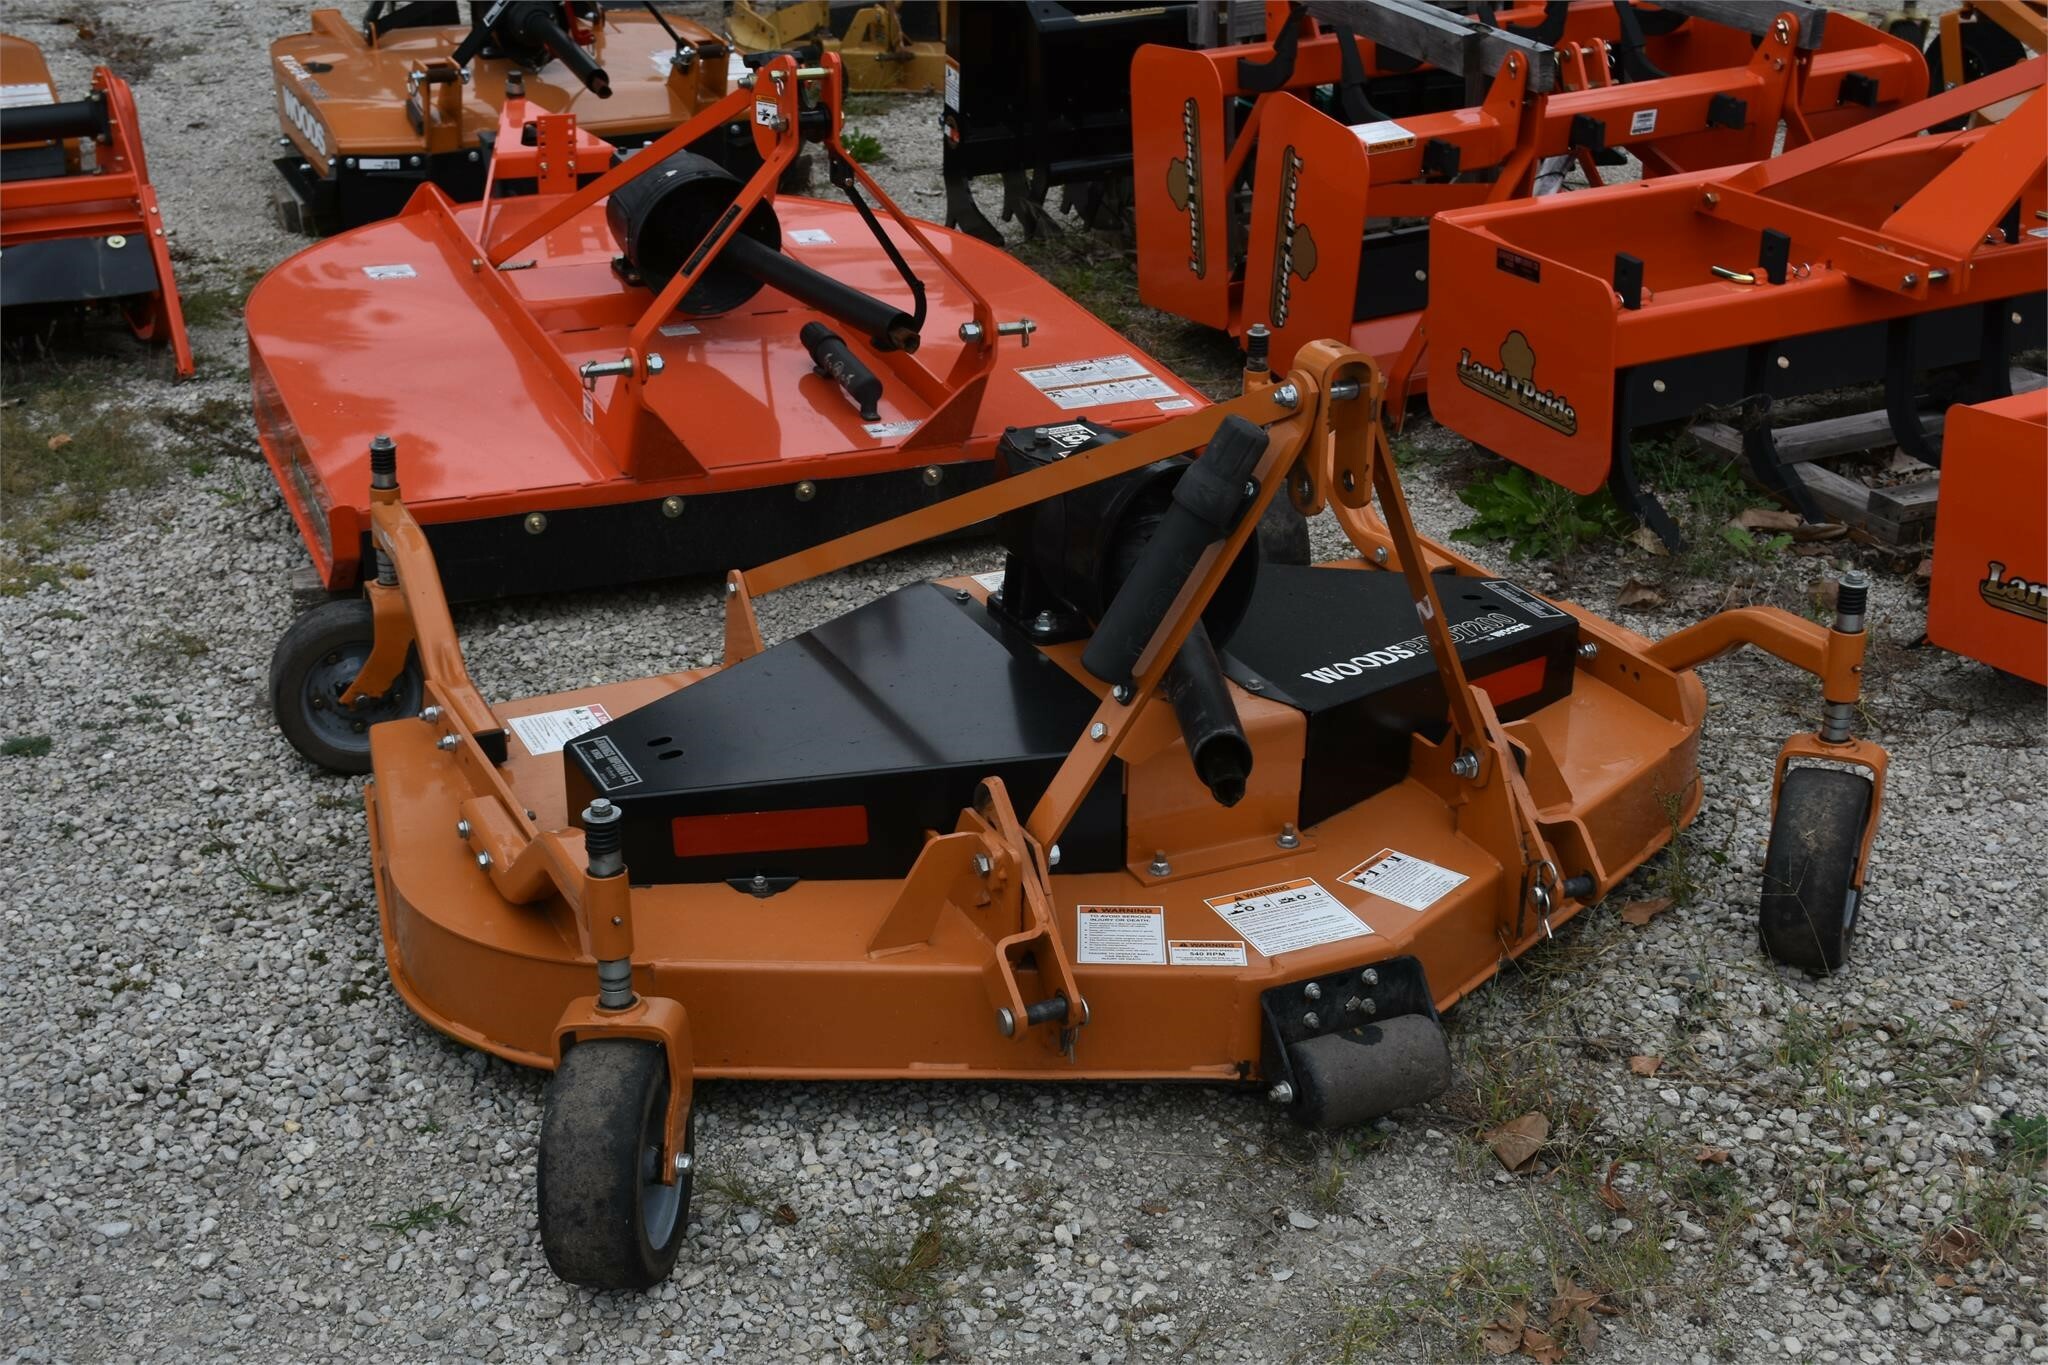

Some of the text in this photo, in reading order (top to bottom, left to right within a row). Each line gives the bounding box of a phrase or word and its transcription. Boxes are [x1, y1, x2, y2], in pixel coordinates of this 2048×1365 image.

[282, 84, 327, 157] WOODS
[1275, 155, 1303, 327] Land Pride
[1458, 347, 1577, 427] Land Pride
[1300, 645, 1416, 684] WOODS
[1242, 883, 1292, 899] WARNING
